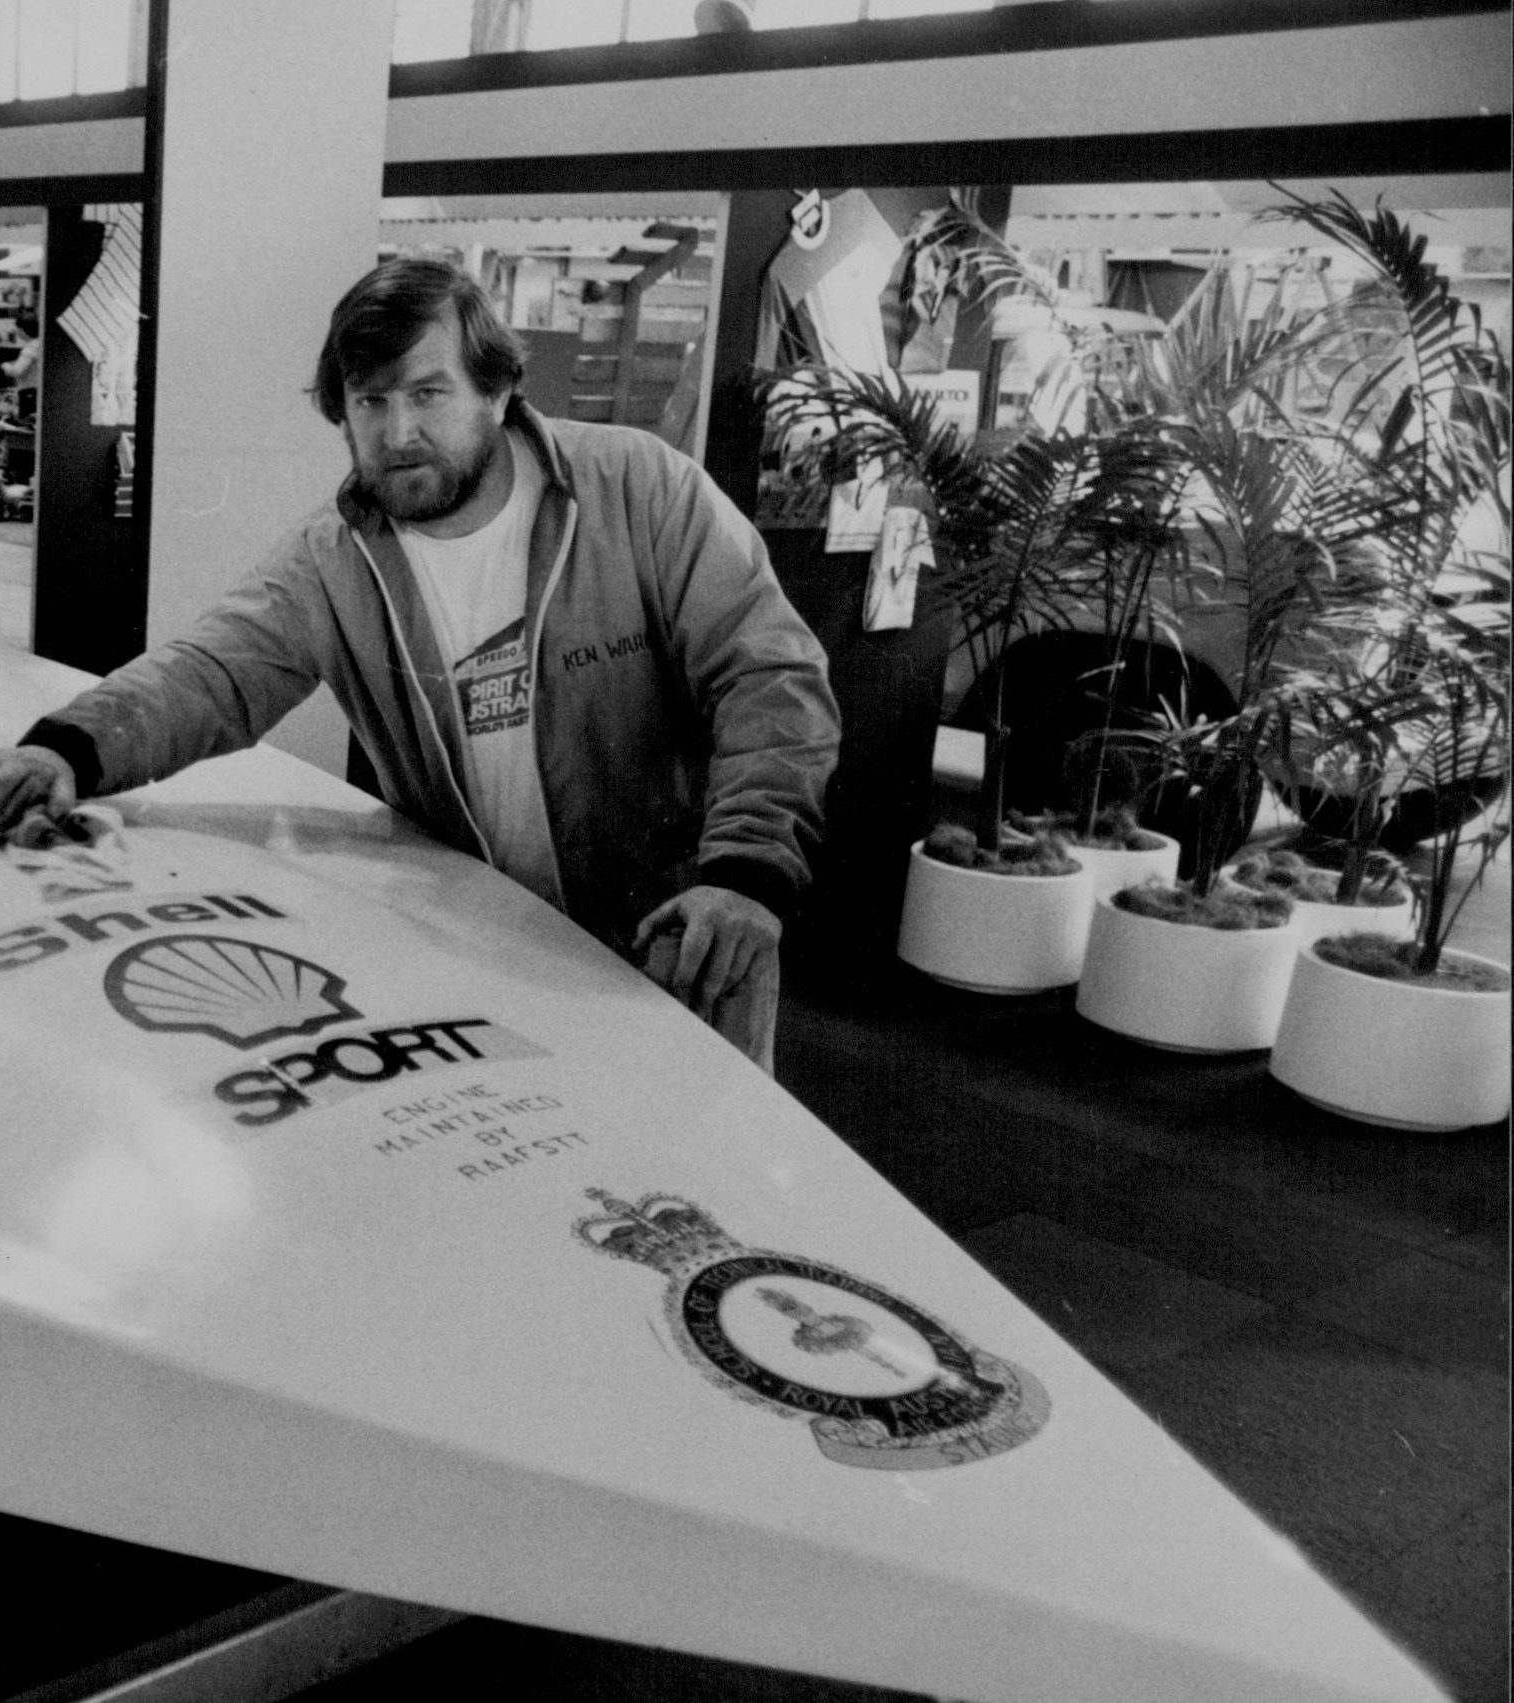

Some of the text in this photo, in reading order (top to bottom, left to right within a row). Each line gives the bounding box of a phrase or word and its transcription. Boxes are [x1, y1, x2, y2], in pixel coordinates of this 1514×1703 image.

[476, 646, 517, 667] SPEEDO
[562, 633, 646, 671] KEN WAR
[469, 674, 517, 700] PIRIT
[213, 1018, 492, 1128] SPORT
[382, 1083, 500, 1125] ENGINE
[373, 1095, 564, 1157] MAINTAINED
[473, 1125, 517, 1148] BY
[456, 1131, 590, 1181] RAAFSTT
